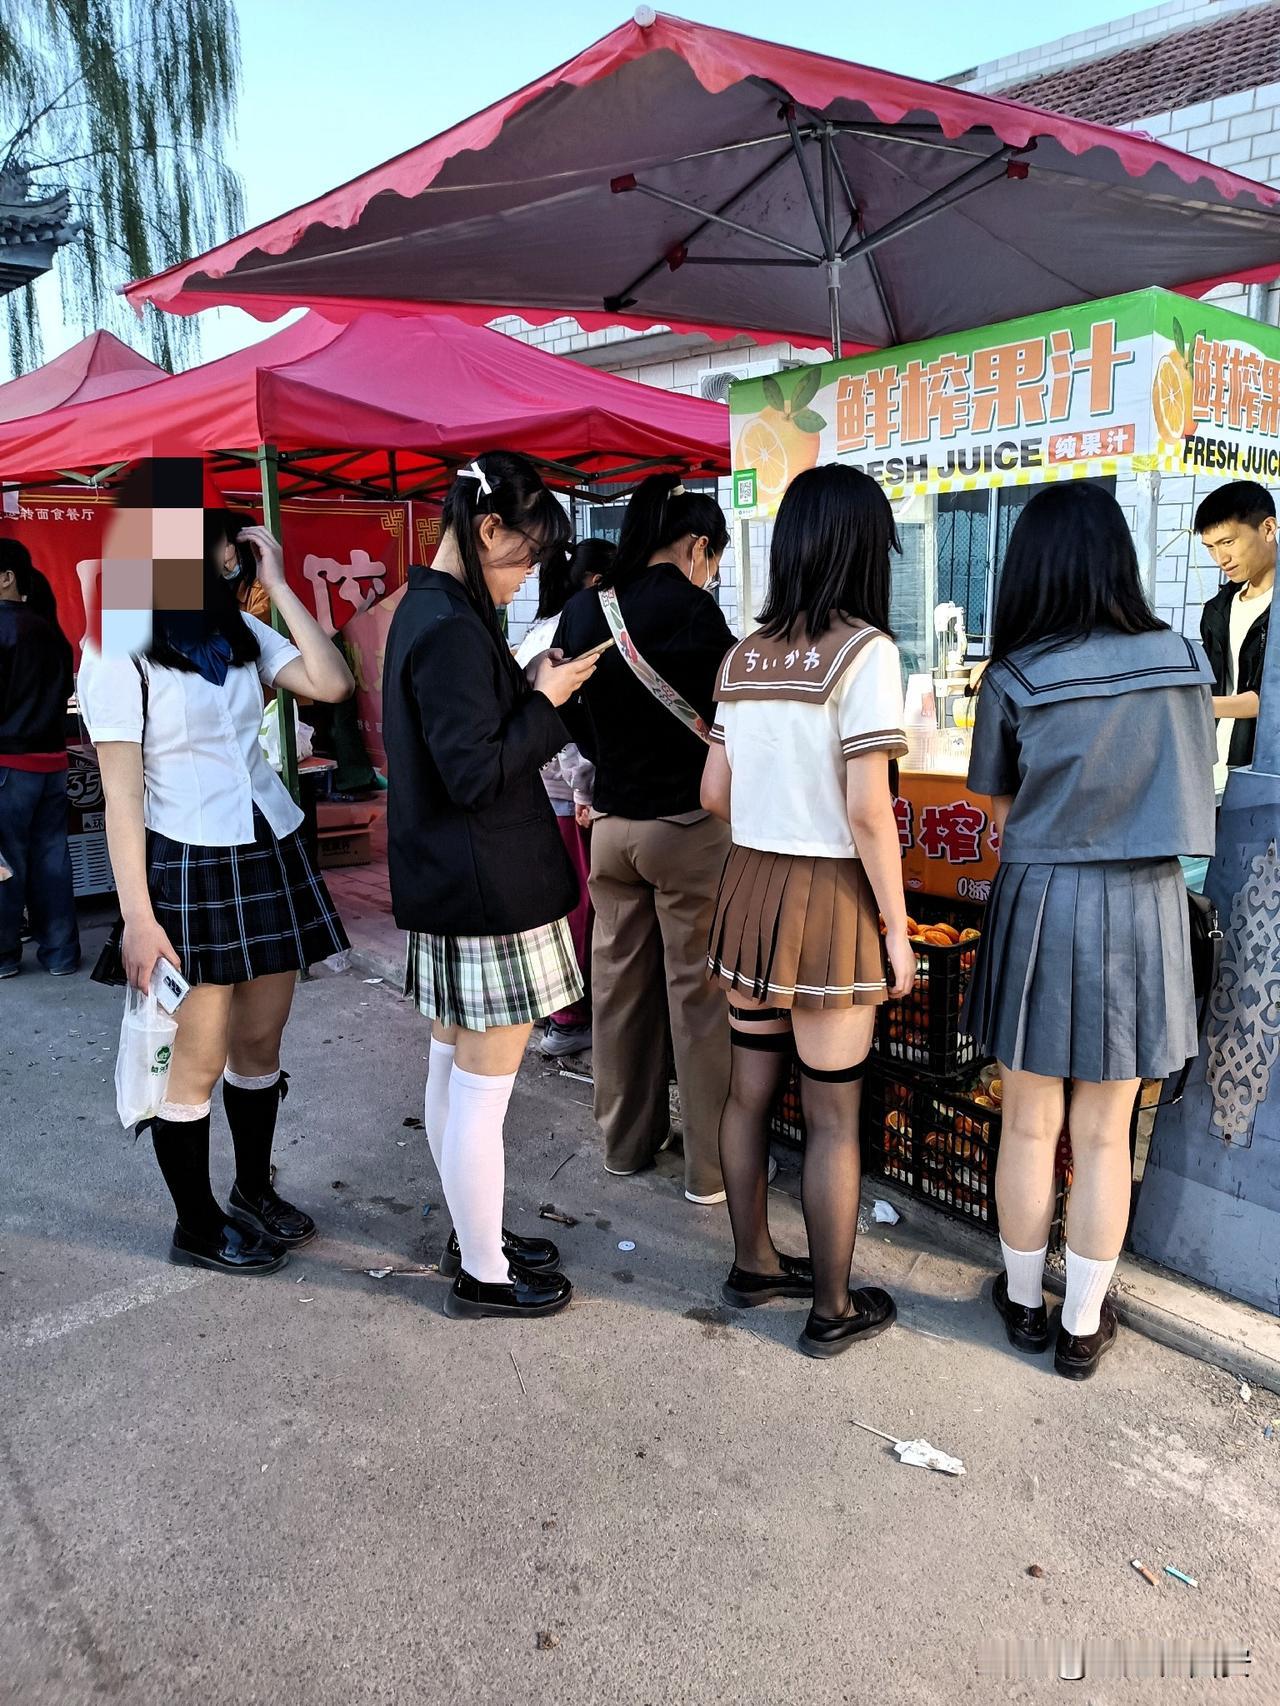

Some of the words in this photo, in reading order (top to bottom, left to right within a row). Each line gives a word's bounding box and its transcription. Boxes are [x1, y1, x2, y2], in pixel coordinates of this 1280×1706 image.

[836, 319, 1136, 454] 鲜榨果汁
[938, 437, 1042, 479] JUICE
[1055, 427, 1129, 460] 纯果汁
[1184, 435, 1239, 471] FRESH
[1242, 445, 1280, 476] JUIC
